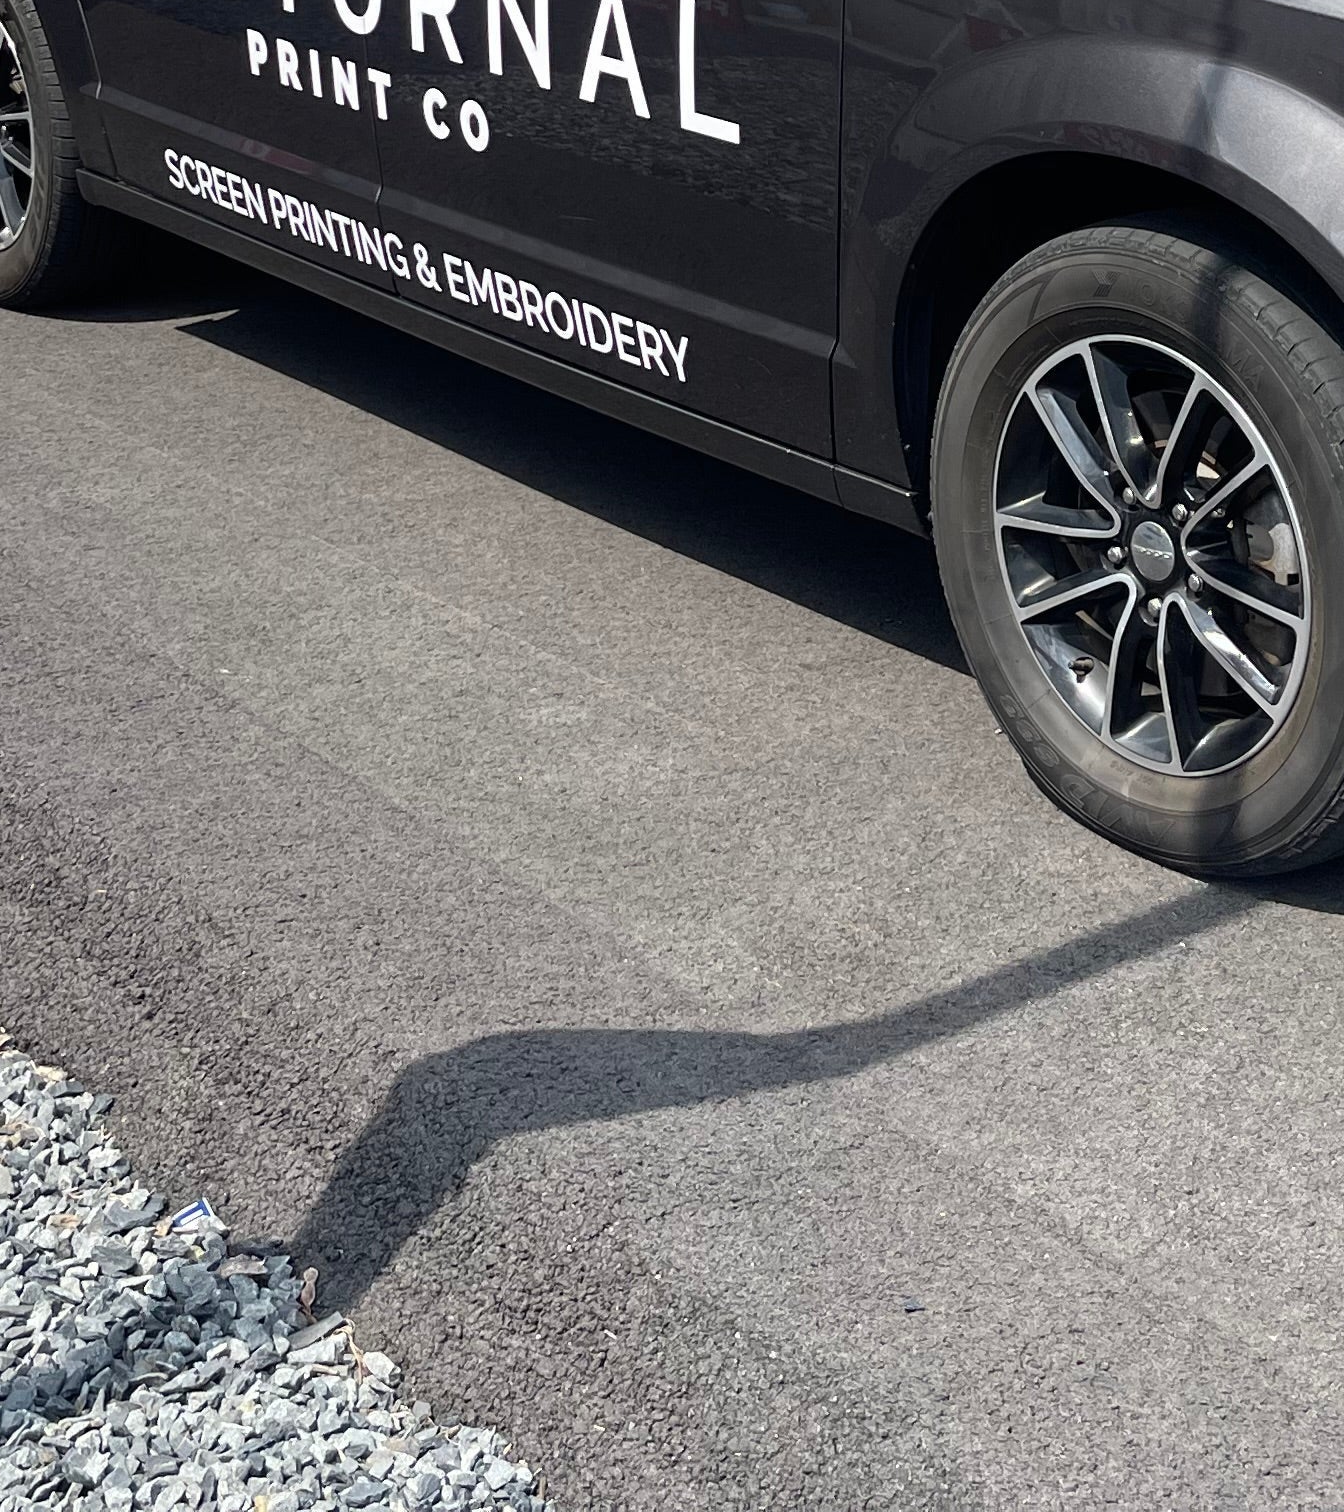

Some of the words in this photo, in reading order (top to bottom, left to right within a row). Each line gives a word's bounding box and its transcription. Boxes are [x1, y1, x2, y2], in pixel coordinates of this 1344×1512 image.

[246, 29, 392, 120] PRINT
[422, 88, 490, 152] CO
[164, 148, 268, 224] SCREEN
[268, 188, 410, 278] PRINTING
[413, 243, 442, 292] &
[443, 253, 689, 382] EMBROIDERY
